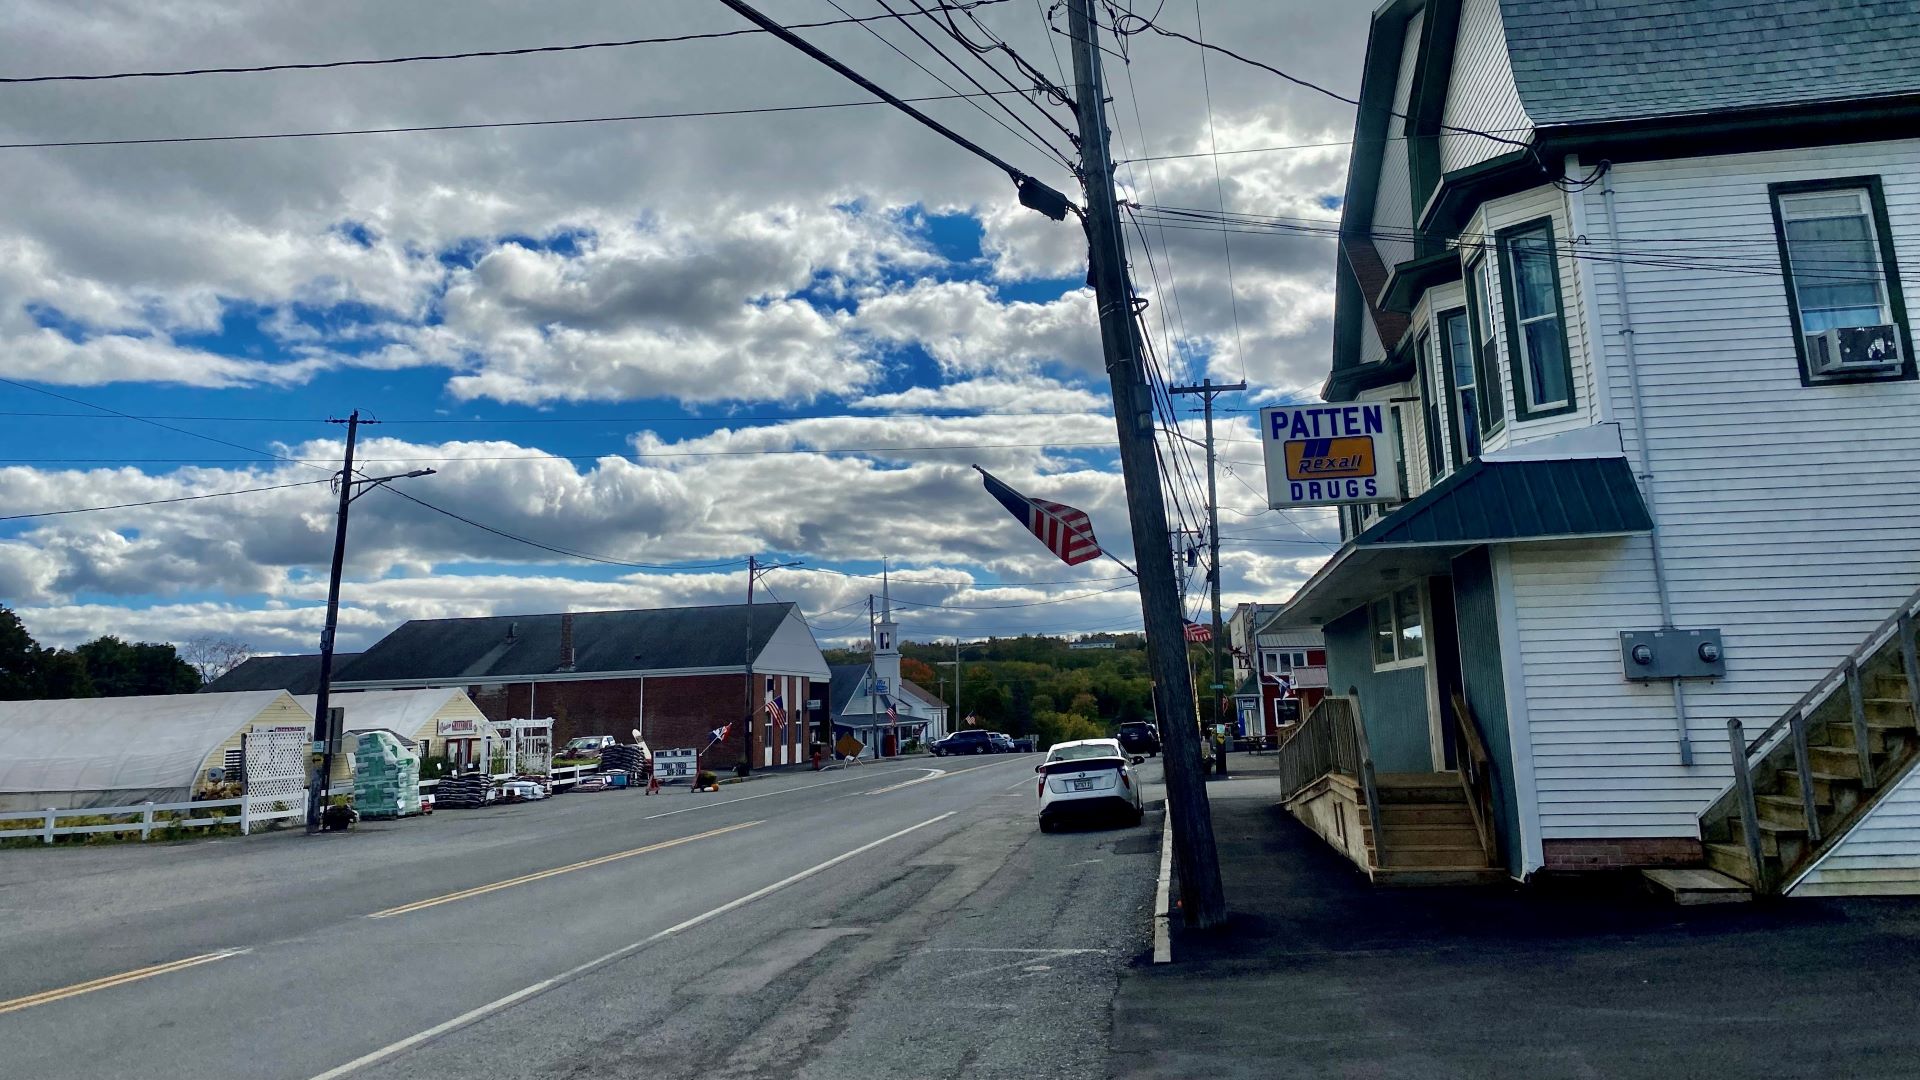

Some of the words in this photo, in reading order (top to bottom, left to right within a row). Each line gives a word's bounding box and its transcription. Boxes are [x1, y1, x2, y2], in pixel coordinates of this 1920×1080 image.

[1271, 405, 1383, 439] PATTEN
[1298, 454, 1363, 474] Rexall
[1290, 478, 1377, 501] DRUGS
